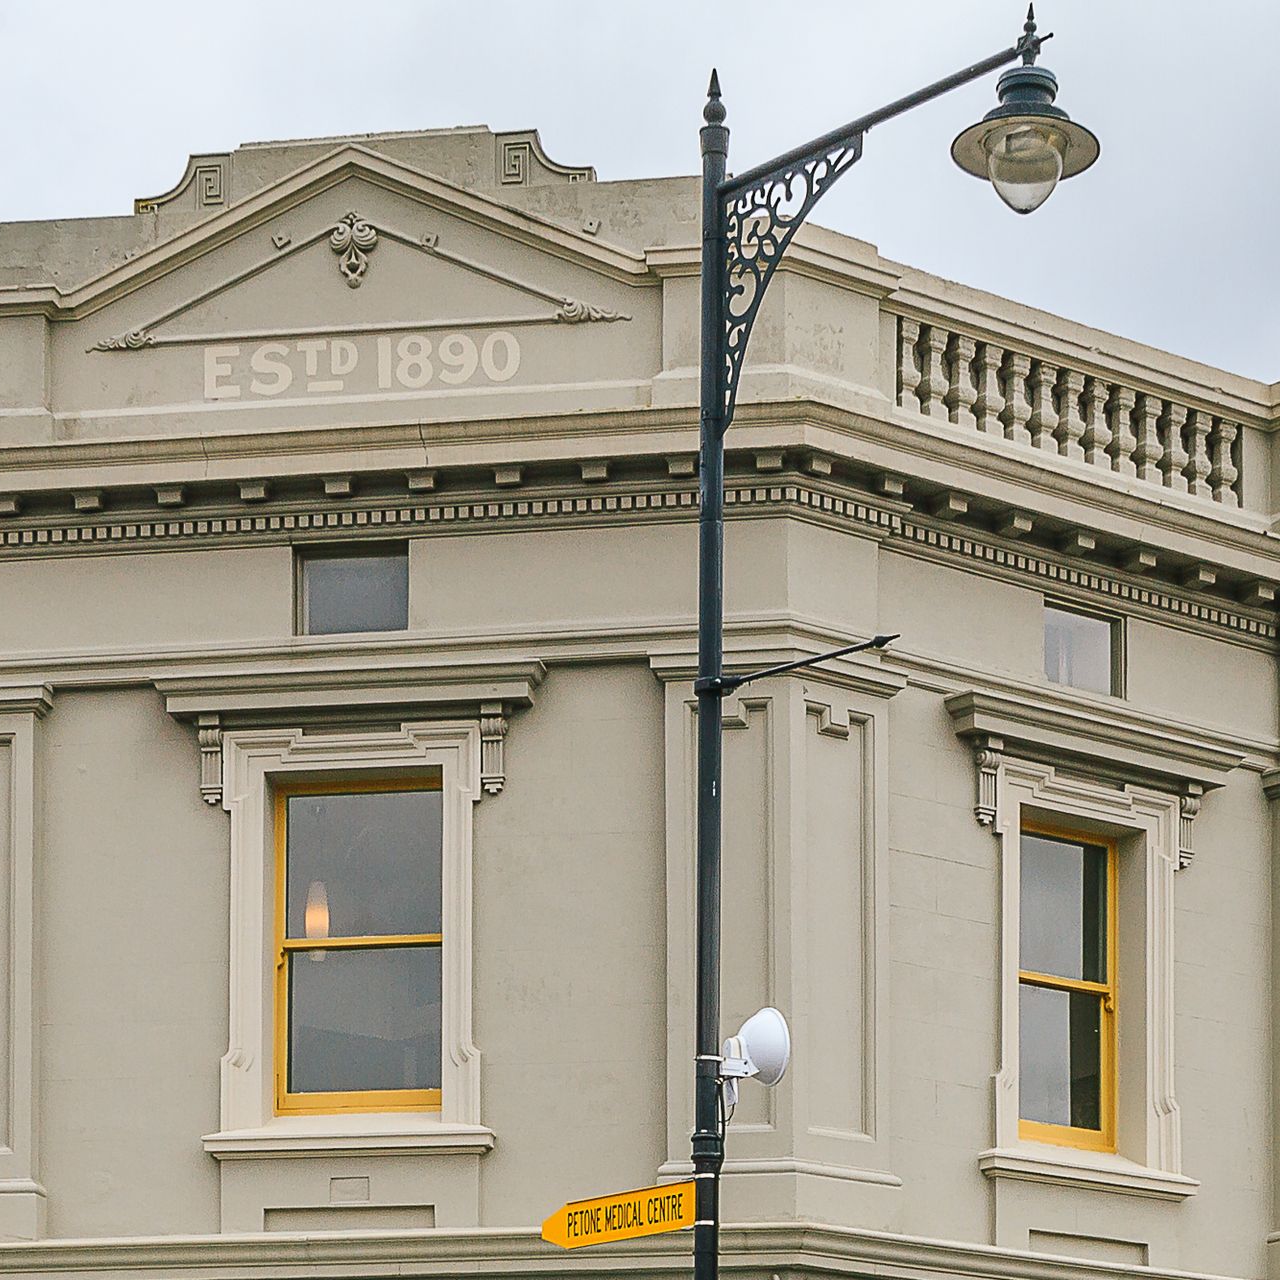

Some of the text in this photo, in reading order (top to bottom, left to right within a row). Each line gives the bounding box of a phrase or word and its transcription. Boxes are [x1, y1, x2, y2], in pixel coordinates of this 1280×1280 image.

[376, 331, 521, 389] 1890
[567, 1193, 683, 1238] PETONE MEDICAL CENTRE
